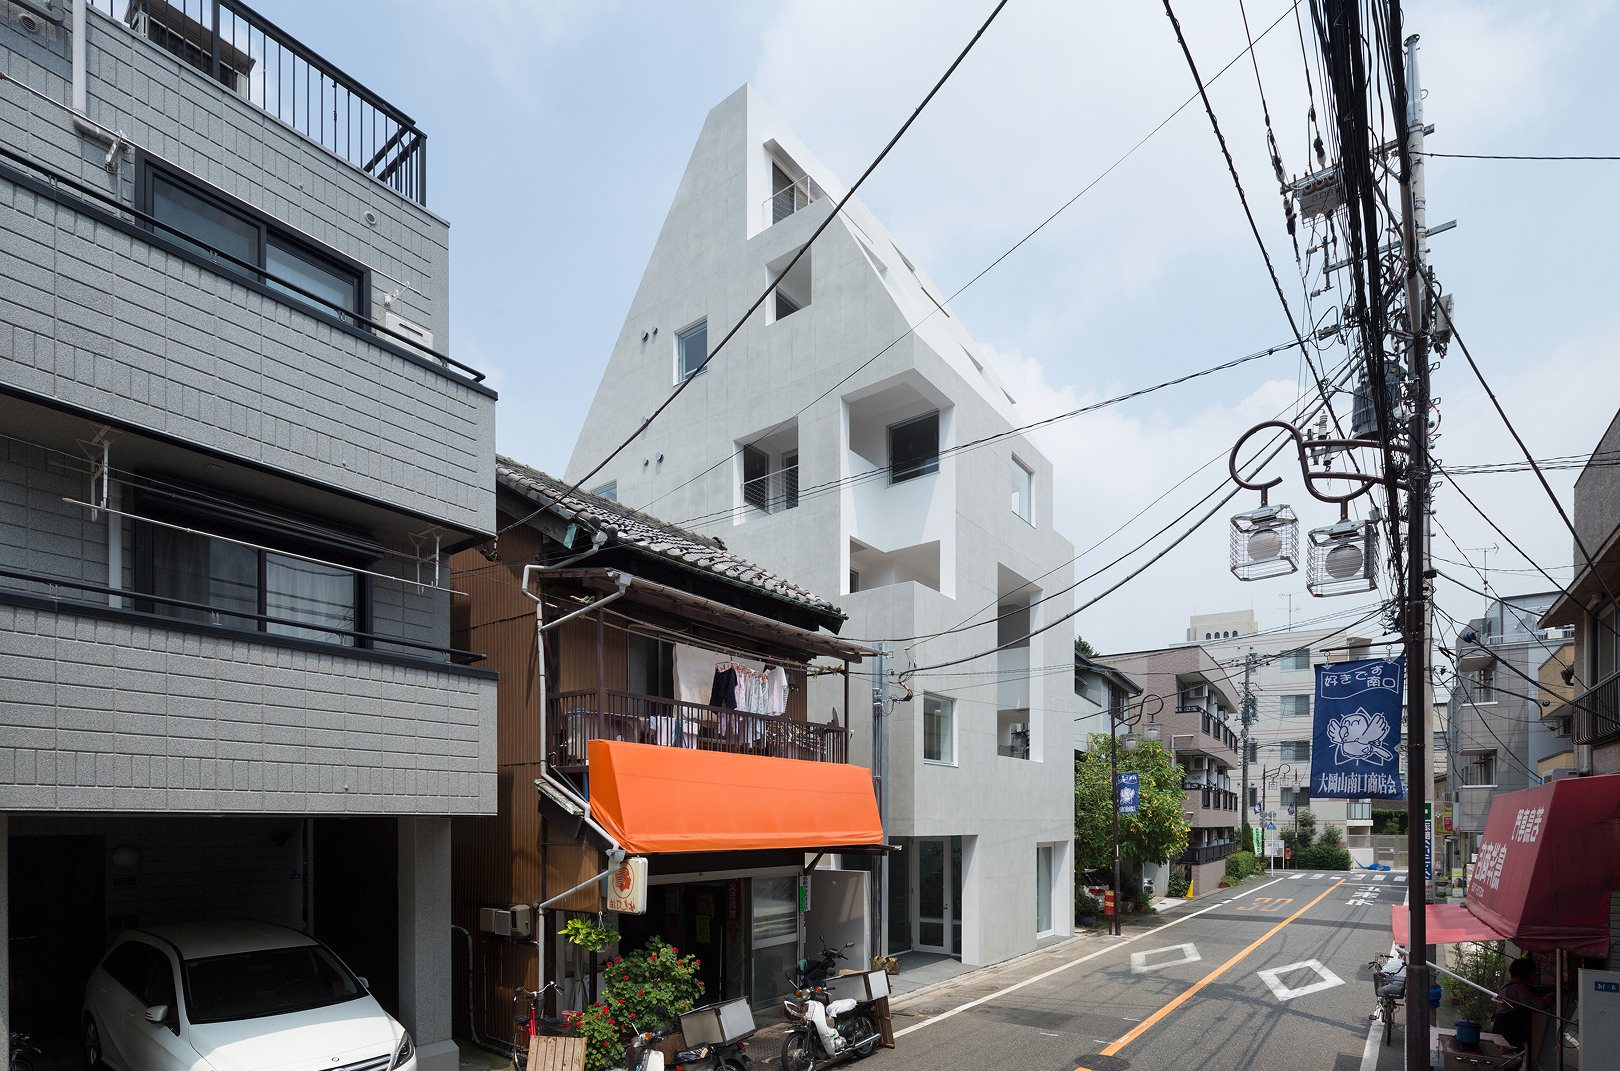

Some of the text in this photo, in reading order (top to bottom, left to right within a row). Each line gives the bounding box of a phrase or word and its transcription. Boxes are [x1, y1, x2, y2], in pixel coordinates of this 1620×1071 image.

[1324, 665, 1384, 687] 好きです
[1366, 675, 1396, 688] 南口
[1317, 772, 1397, 795] 大岡山南口商店会
[1236, 897, 1294, 912] 30
